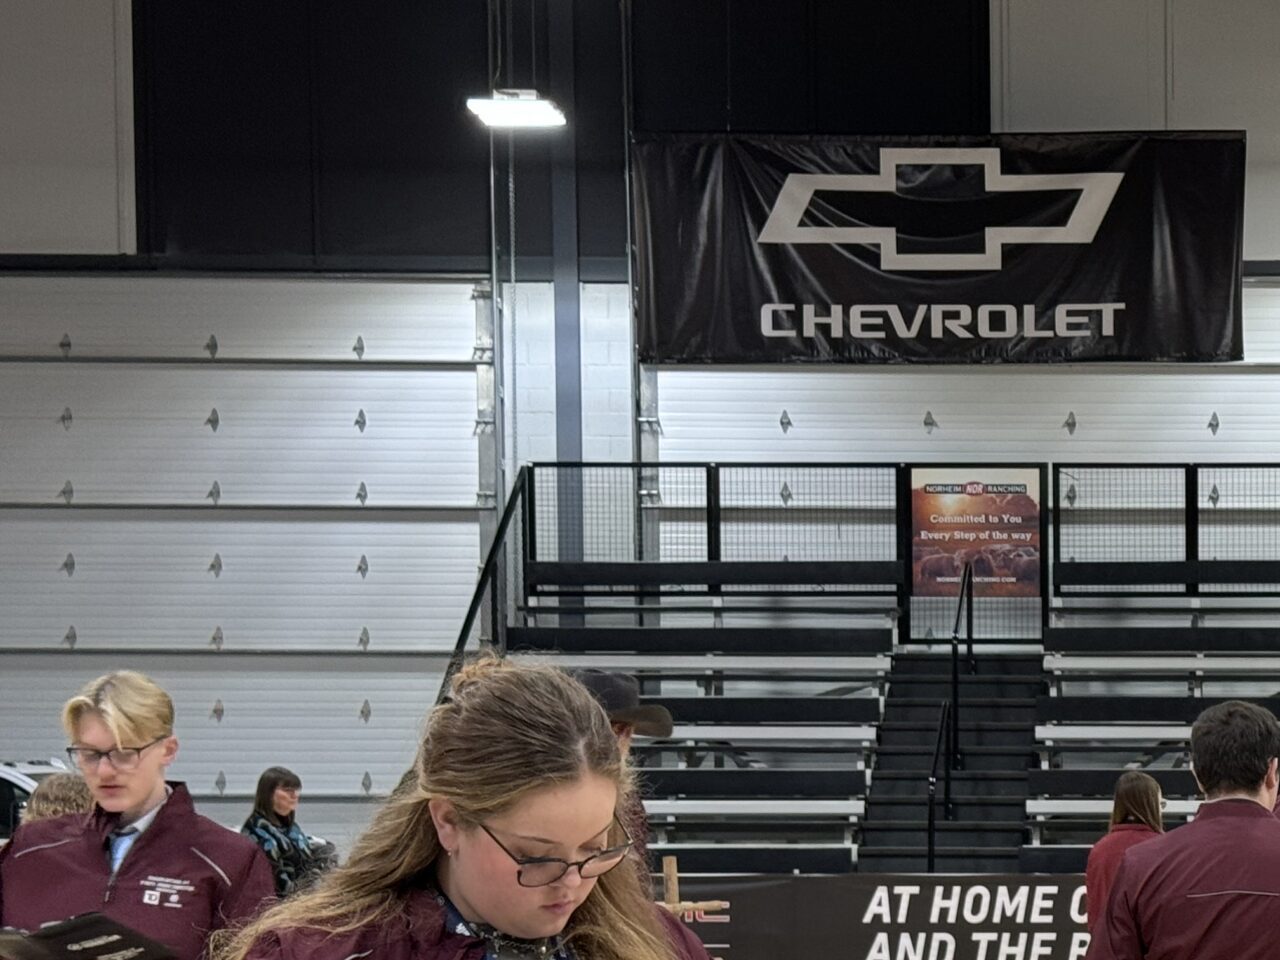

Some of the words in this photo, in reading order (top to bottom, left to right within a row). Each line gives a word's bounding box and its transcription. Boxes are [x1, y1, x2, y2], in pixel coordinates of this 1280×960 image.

[761, 303, 1126, 338] CHEVROLET
[929, 514, 986, 523] Committed
[989, 514, 999, 523] to
[1002, 514, 1022, 523] You
[920, 530, 950, 541] Every
[953, 530, 976, 542] Step
[979, 530, 990, 539] of
[992, 530, 1008, 539] the
[1011, 532, 1032, 541] way
[863, 886, 920, 924] AT
[930, 886, 1059, 924] HOME
[1070, 885, 1088, 924] O
